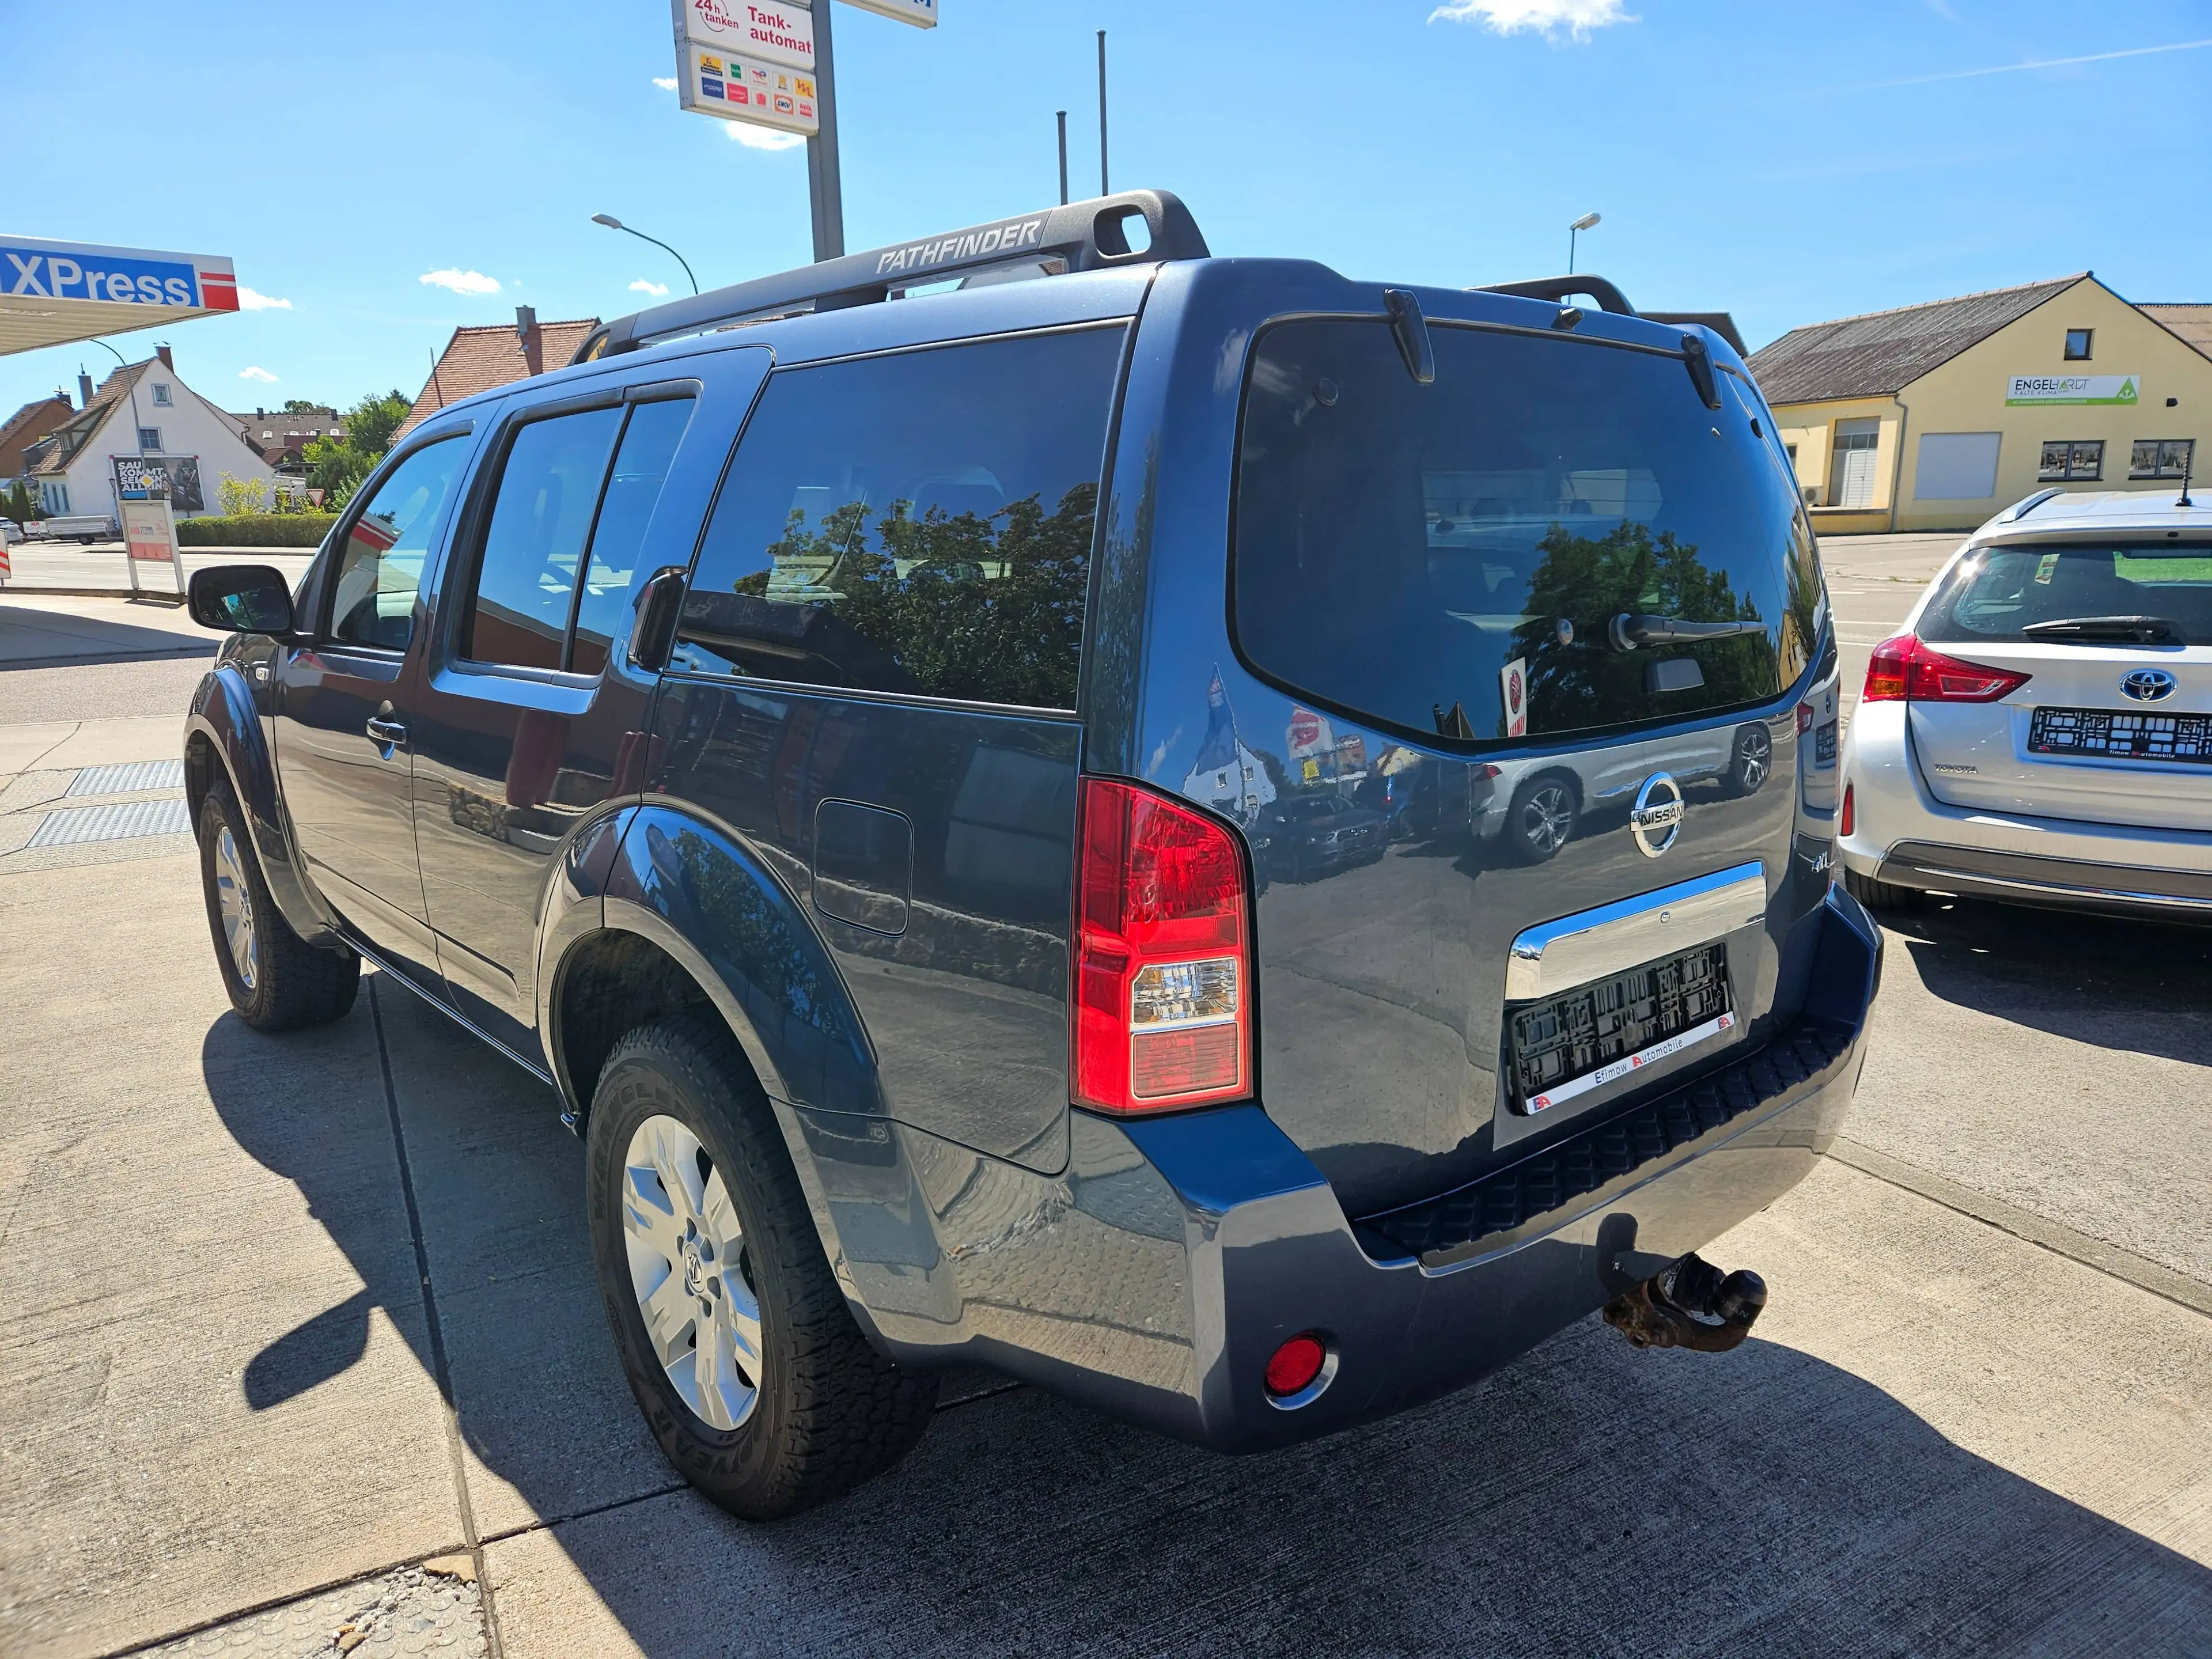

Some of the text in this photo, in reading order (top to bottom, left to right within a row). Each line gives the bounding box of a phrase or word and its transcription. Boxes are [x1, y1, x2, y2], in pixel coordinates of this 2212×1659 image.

[704, 12, 739, 29] tanken
[747, 6, 791, 29] Tank-
[751, 28, 812, 54] automat
[876, 218, 1041, 274] PATHFINDER
[2016, 379, 2089, 390] ENGELHARDT
[118, 461, 142, 470] SAU
[120, 483, 162, 491] ALLIN
[1934, 764, 1978, 774] TOYOTA
[1640, 805, 1682, 827] NISSAN
[1594, 1038, 1683, 1084] Efimow Automobile
